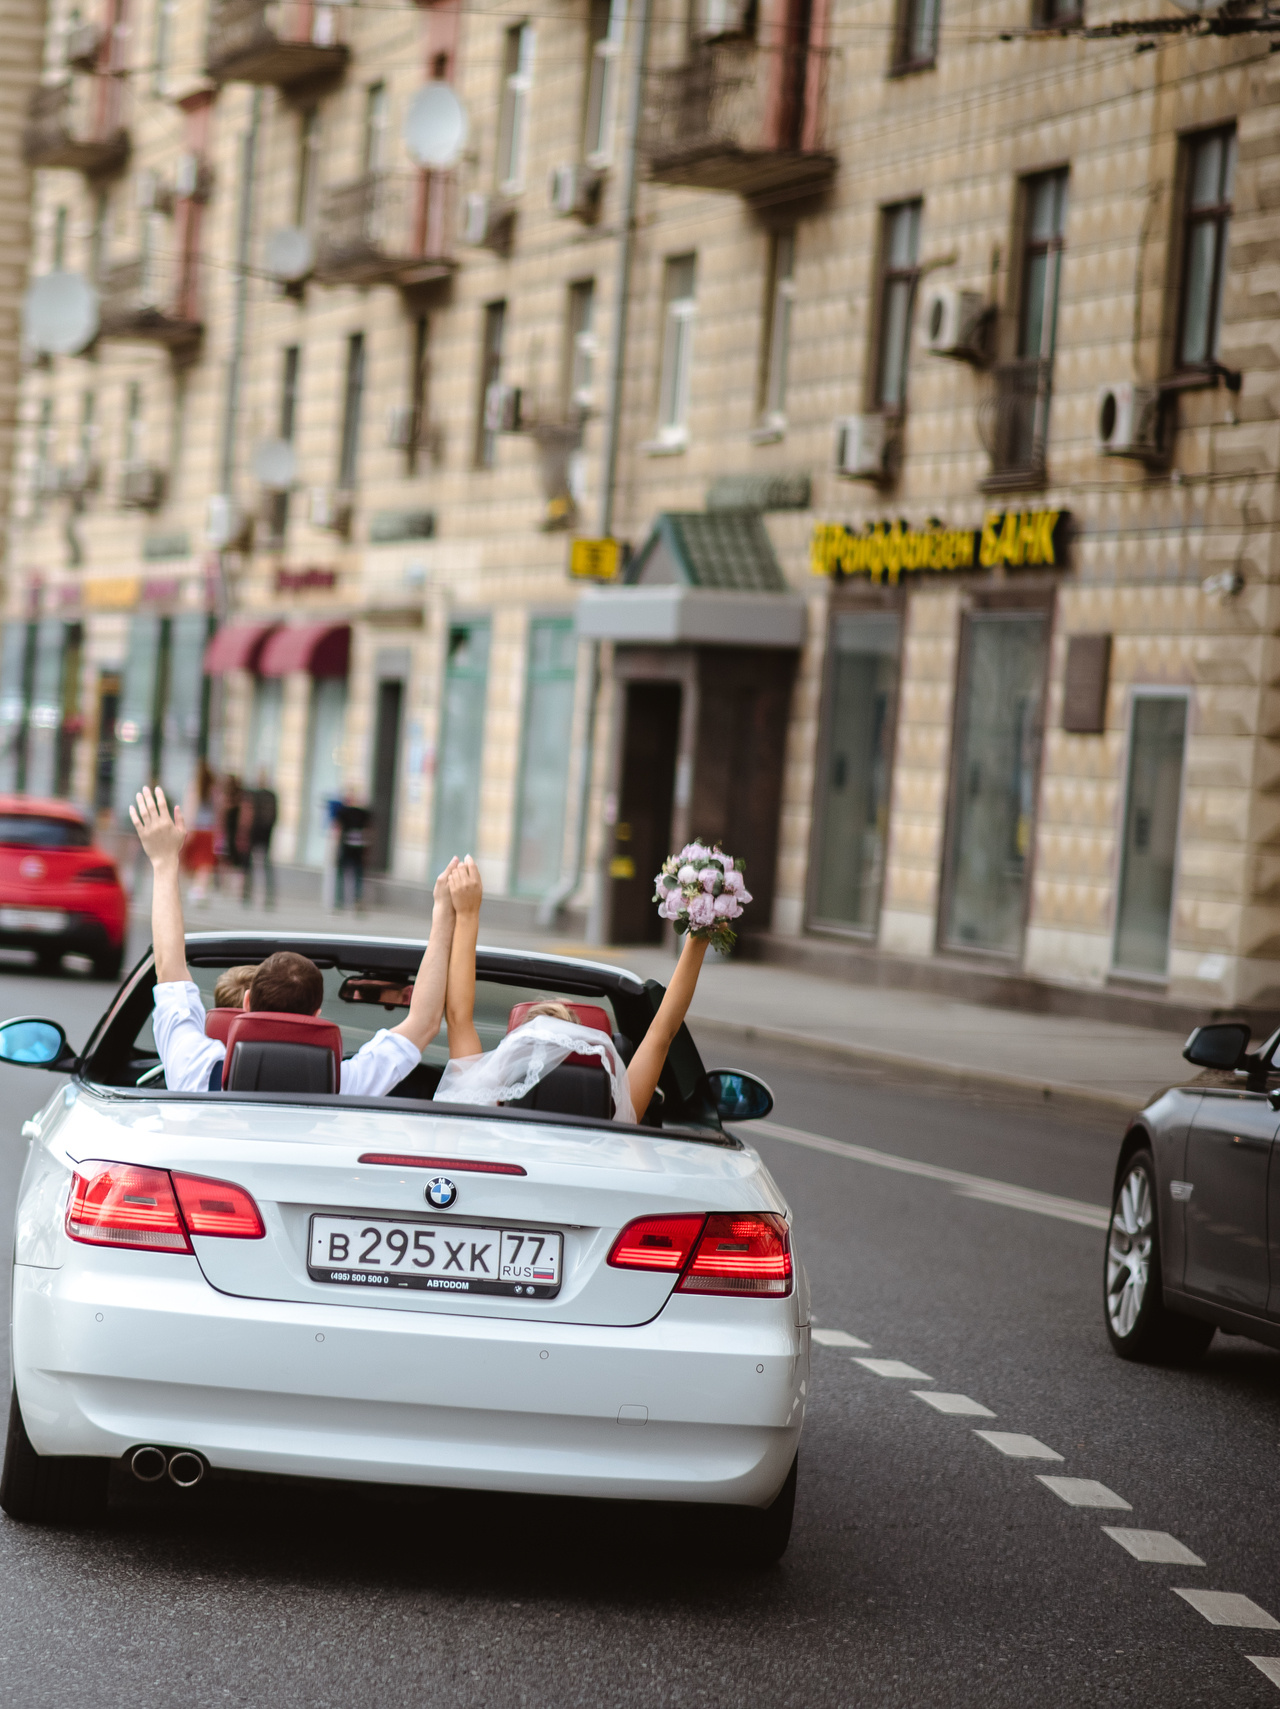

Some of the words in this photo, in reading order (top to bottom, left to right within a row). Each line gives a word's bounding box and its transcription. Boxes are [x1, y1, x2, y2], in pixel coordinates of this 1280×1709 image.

[979, 509, 1060, 567] БАНК
[506, 1234, 546, 1266] 77
[330, 1272, 350, 1281] (495)
[351, 1273, 366, 1282] 500
[368, 1275, 382, 1283] 500
[383, 1276, 389, 1284] 0
[502, 1265, 532, 1278] RUS
